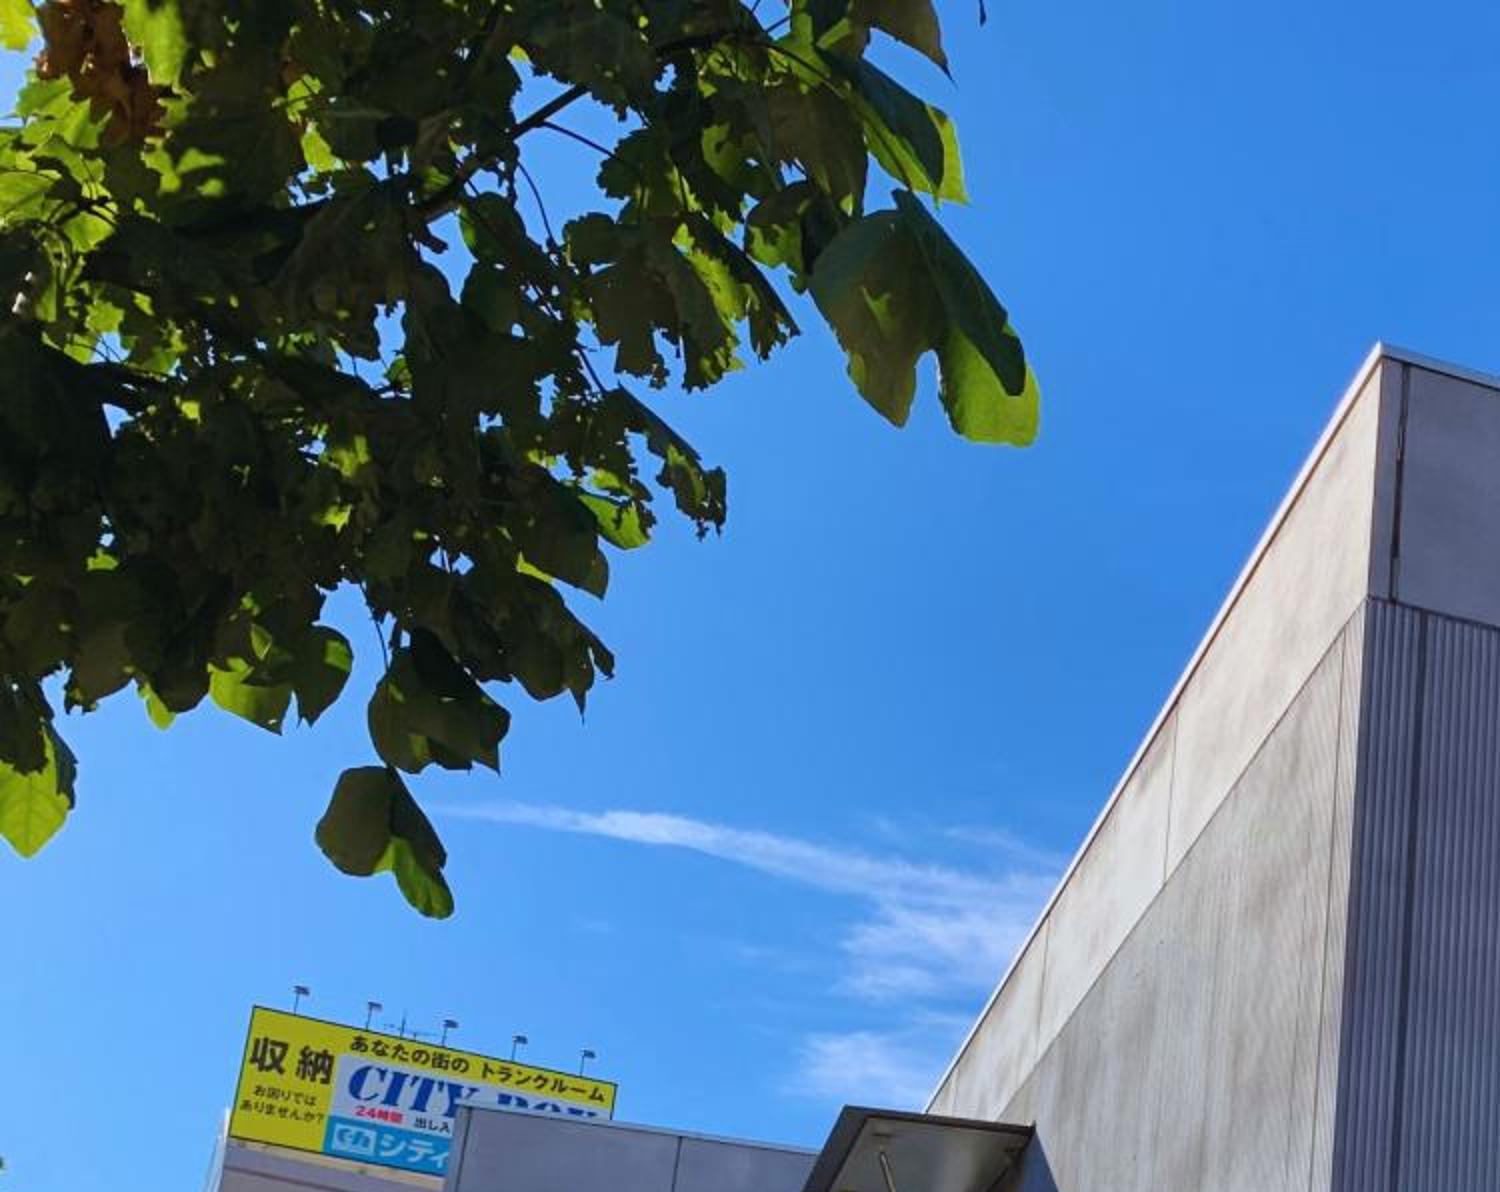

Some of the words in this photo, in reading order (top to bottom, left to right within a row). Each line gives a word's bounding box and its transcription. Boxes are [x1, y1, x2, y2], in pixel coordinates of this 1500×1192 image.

[249, 1036, 335, 1085] 収納
[348, 1034, 469, 1075] あなたの街の
[480, 1061, 605, 1104] トランクルーム
[348, 1064, 480, 1118] CITY
